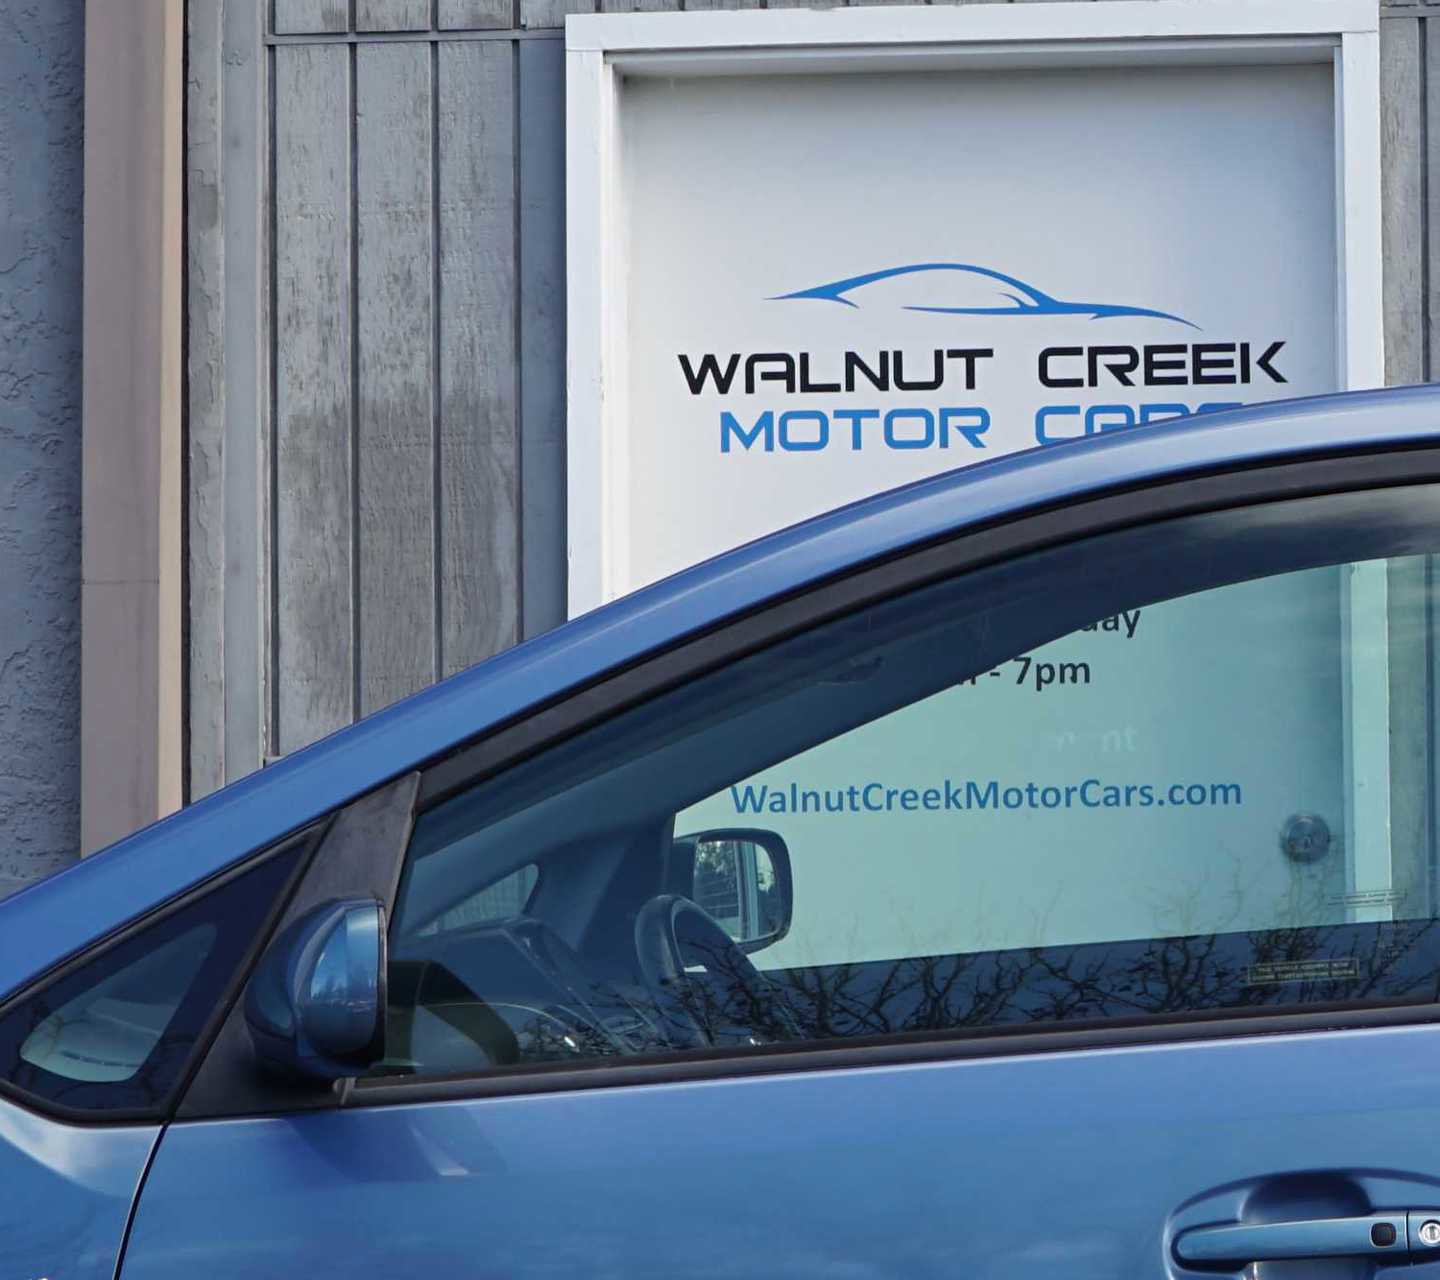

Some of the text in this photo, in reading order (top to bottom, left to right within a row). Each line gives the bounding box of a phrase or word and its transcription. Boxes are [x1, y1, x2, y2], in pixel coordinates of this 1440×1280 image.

[677, 341, 1288, 395] WALNUT CREEK
[720, 402, 1243, 453] MOTOR CA
[1013, 656, 1091, 692] 7pm
[731, 778, 1243, 815] WalnutCreekMotorCars.com
